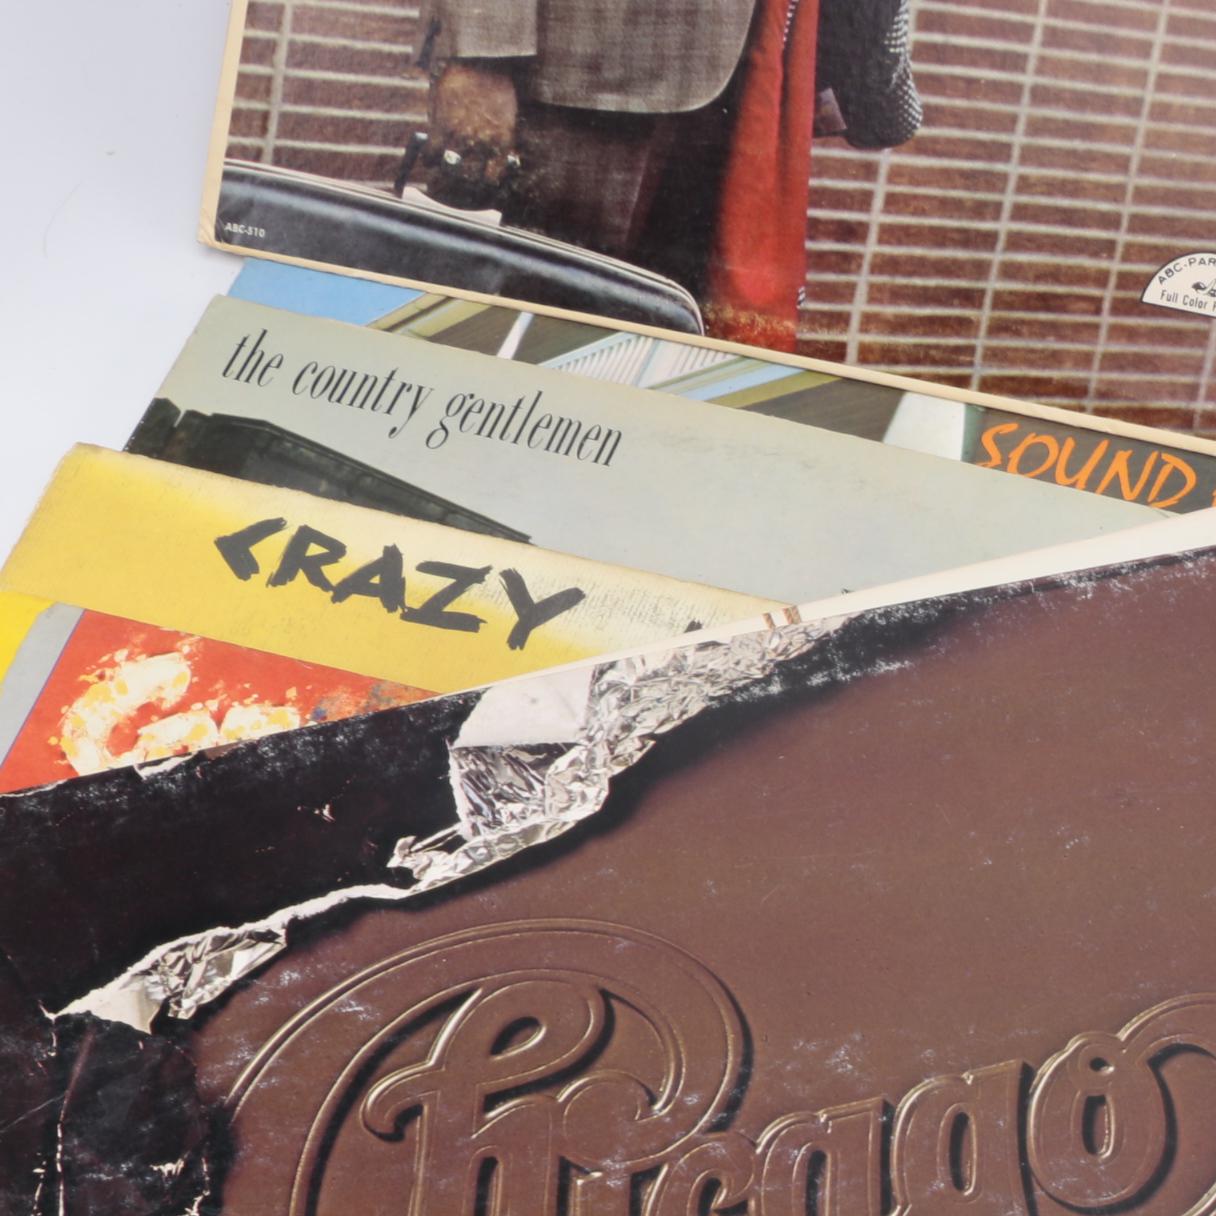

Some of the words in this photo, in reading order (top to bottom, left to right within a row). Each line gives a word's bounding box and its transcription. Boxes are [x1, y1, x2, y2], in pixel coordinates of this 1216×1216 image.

[224, 222, 265, 238] ABC-510
[1160, 290, 1178, 303] Full
[1183, 295, 1208, 310] Color
[222, 329, 284, 388] the
[292, 358, 434, 439] country
[425, 389, 624, 468] gentlemen
[975, 422, 1197, 508] SOUND
[214, 517, 586, 650] CRAZY
